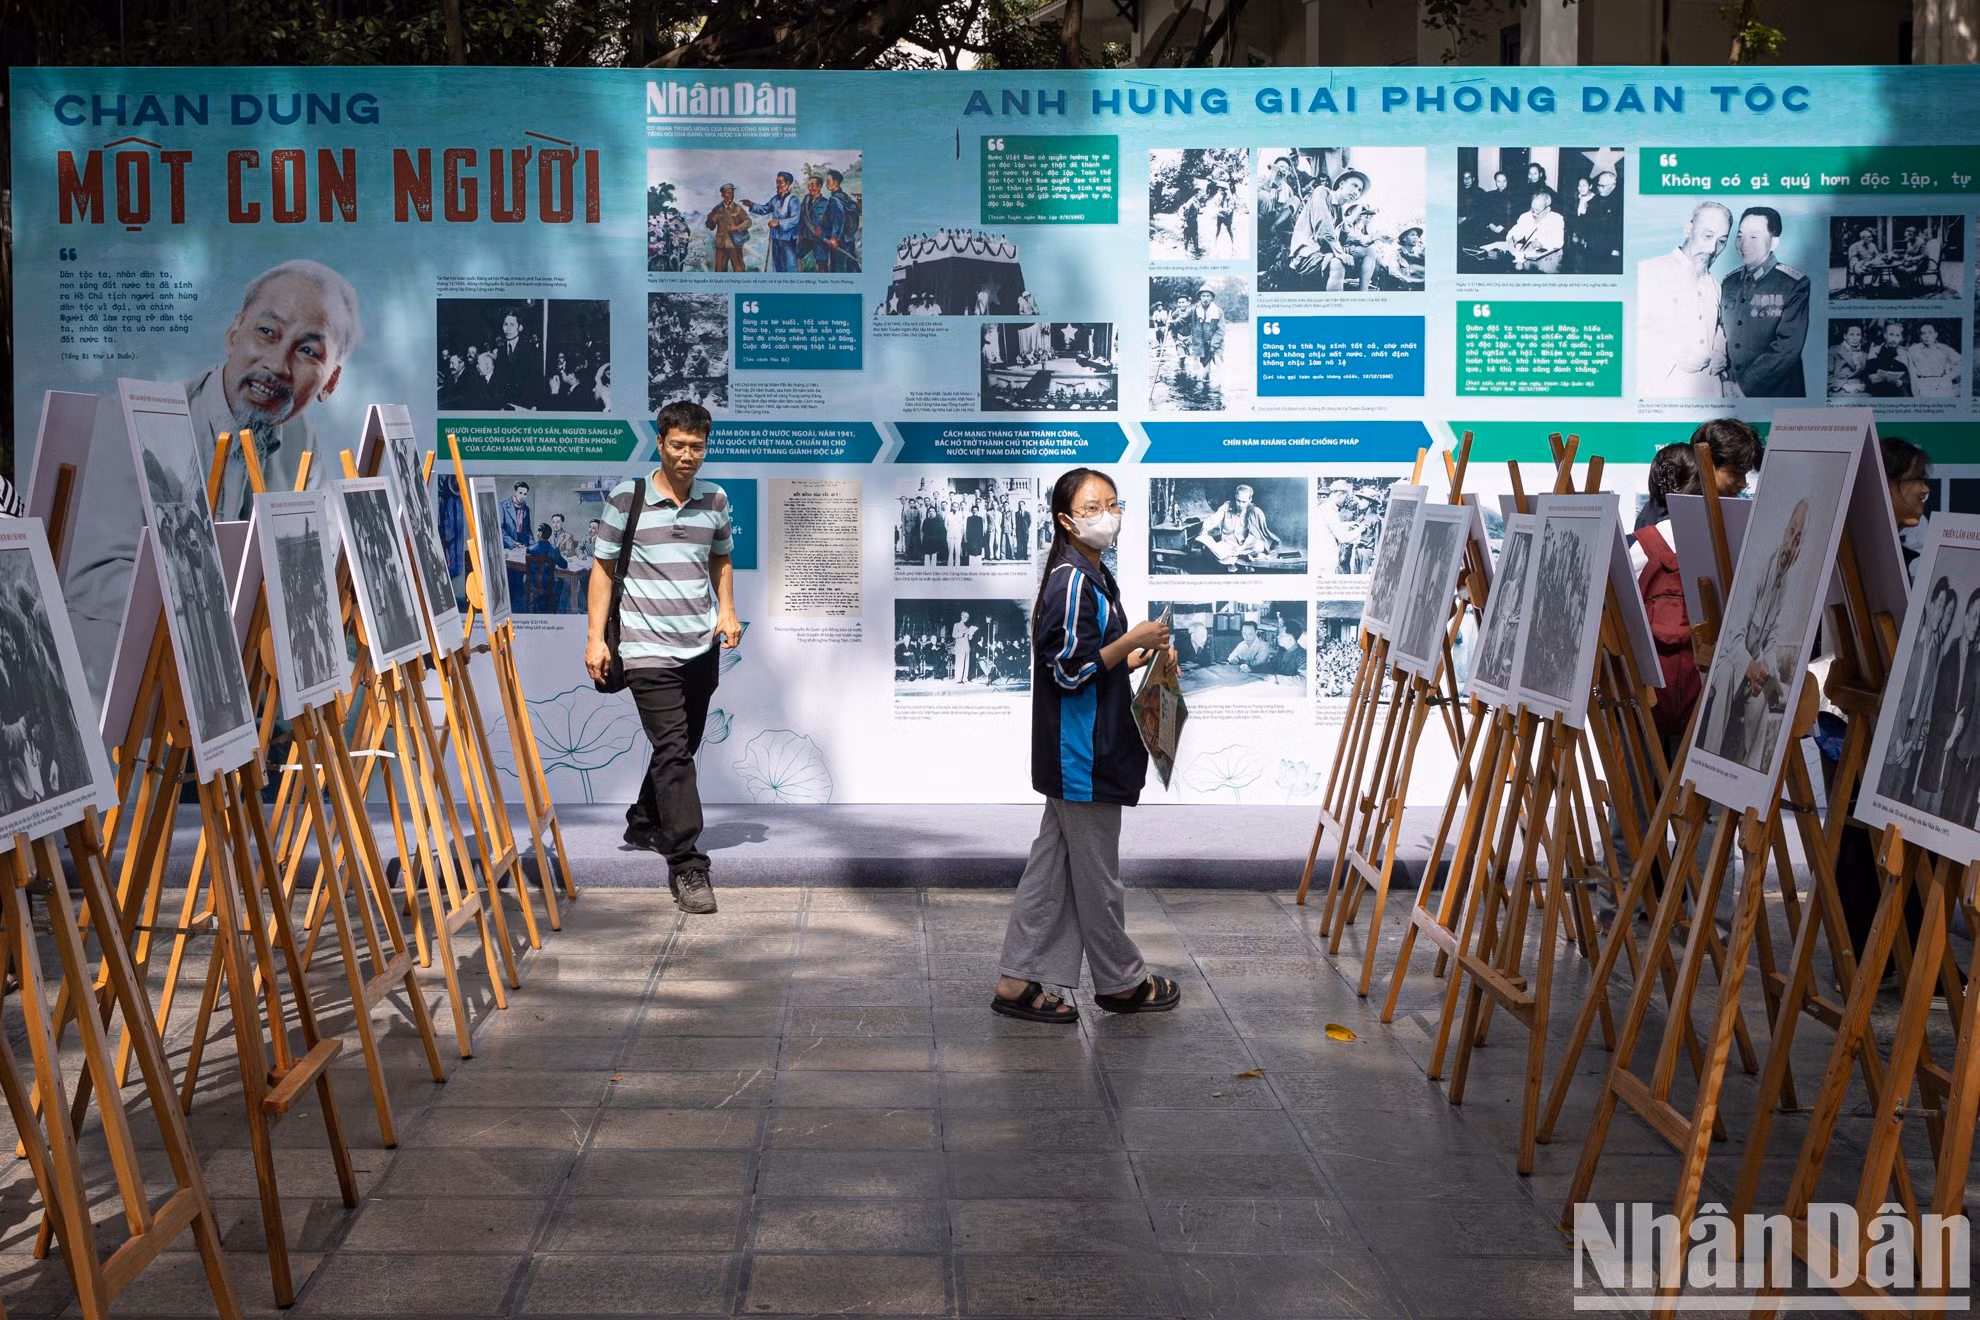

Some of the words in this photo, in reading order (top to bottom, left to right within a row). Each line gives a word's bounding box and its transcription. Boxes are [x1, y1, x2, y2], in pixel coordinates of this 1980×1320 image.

[647, 82, 730, 115] Nhân
[734, 82, 796, 115] Dân
[963, 90, 1066, 115] ANH
[231, 93, 379, 125] DUNG
[58, 137, 192, 232] MỘT
[228, 148, 357, 224] CON
[394, 131, 600, 223] NGƯỜI
[1662, 173, 1712, 190] Không
[1721, 173, 1741, 186] có
[1751, 174, 1770, 190] gì
[1781, 172, 1811, 189] quý
[1821, 173, 1850, 186] hơn
[1860, 172, 1890, 189] độc
[1901, 172, 1939, 188] lập,
[1952, 173, 1972, 188] tự
[79, 271, 93, 280] tộc
[99, 271, 111, 279] ta,
[160, 271, 173, 279] ta,
[80, 282, 98, 290] sông
[103, 280, 116, 289] đất
[122, 281, 140, 289] nước
[159, 281, 169, 289] đã
[74, 292, 84, 300] Hồ
[89, 292, 103, 300] Chủ
[108, 292, 126, 301] tịch
[132, 292, 154, 302] người
[160, 292, 174, 300] anh
[179, 292, 198, 301] hùng
[470, 426, 492, 434] CHIẾN
[494, 426, 500, 434] SĨ
[501, 426, 522, 434] QUỐC
[524, 426, 533, 434] TẾ
[533, 427, 543, 435] VÔ
[545, 427, 561, 435] SẢN,
[610, 428, 623, 436] LẬP
[716, 429, 733, 437] NĂM
[734, 429, 750, 437] BÔN
[762, 429, 768, 437] Ở
[964, 431, 987, 439] MẠNG
[1058, 430, 1081, 438] CÔNG,
[484, 436, 505, 445] CỘNG
[522, 436, 538, 445] VIỆT
[560, 437, 573, 445] ĐỘI
[717, 438, 724, 446] ÁI
[726, 438, 747, 446] QUỐC
[748, 438, 757, 446] VỀ
[758, 438, 774, 447] VIỆT
[796, 438, 820, 446] CHUẨN
[822, 440, 830, 448] BỊ
[951, 438, 962, 446] HỒ
[963, 438, 978, 446] TRỞ
[1005, 438, 1020, 446] CHỦ
[1022, 440, 1038, 448] TỊCH
[1039, 438, 1055, 446] ĐẦU
[1074, 438, 1089, 446] CỦA
[1223, 438, 1241, 446] CHÍN
[1242, 438, 1259, 446] NĂM
[1261, 438, 1287, 446] KHÁNG
[1288, 438, 1310, 446] CHIẾN
[466, 444, 480, 452] CỦA
[554, 446, 568, 454] TỘC
[569, 446, 584, 454] VIỆT
[709, 447, 725, 455] ĐẤU
[752, 447, 762, 455] VŨ
[814, 448, 830, 456] ĐỘC
[831, 448, 845, 457] LẬP
[969, 448, 985, 457] VIỆT
[1039, 448, 1060, 457] CỘNG
